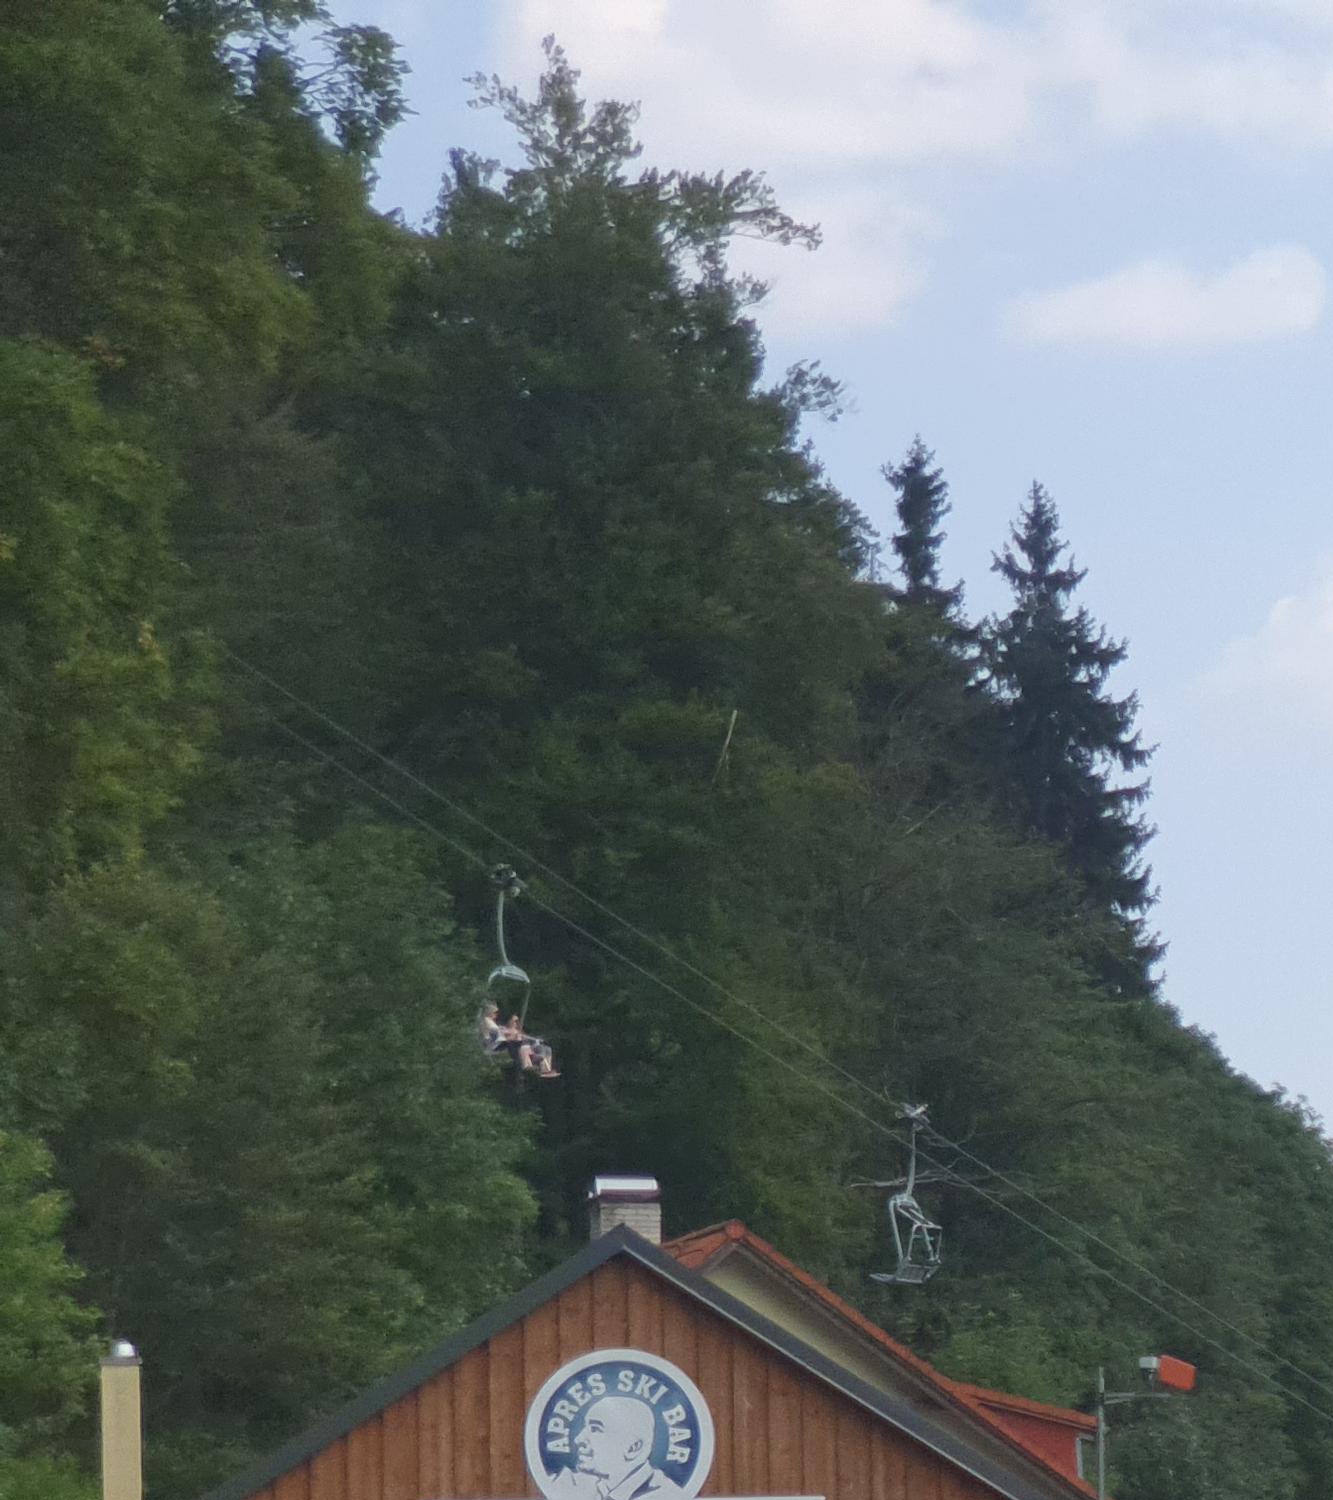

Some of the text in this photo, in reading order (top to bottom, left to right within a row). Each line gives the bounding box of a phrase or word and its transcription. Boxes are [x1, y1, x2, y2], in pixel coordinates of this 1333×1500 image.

[546, 1369, 693, 1465] APRES SKI BAR
